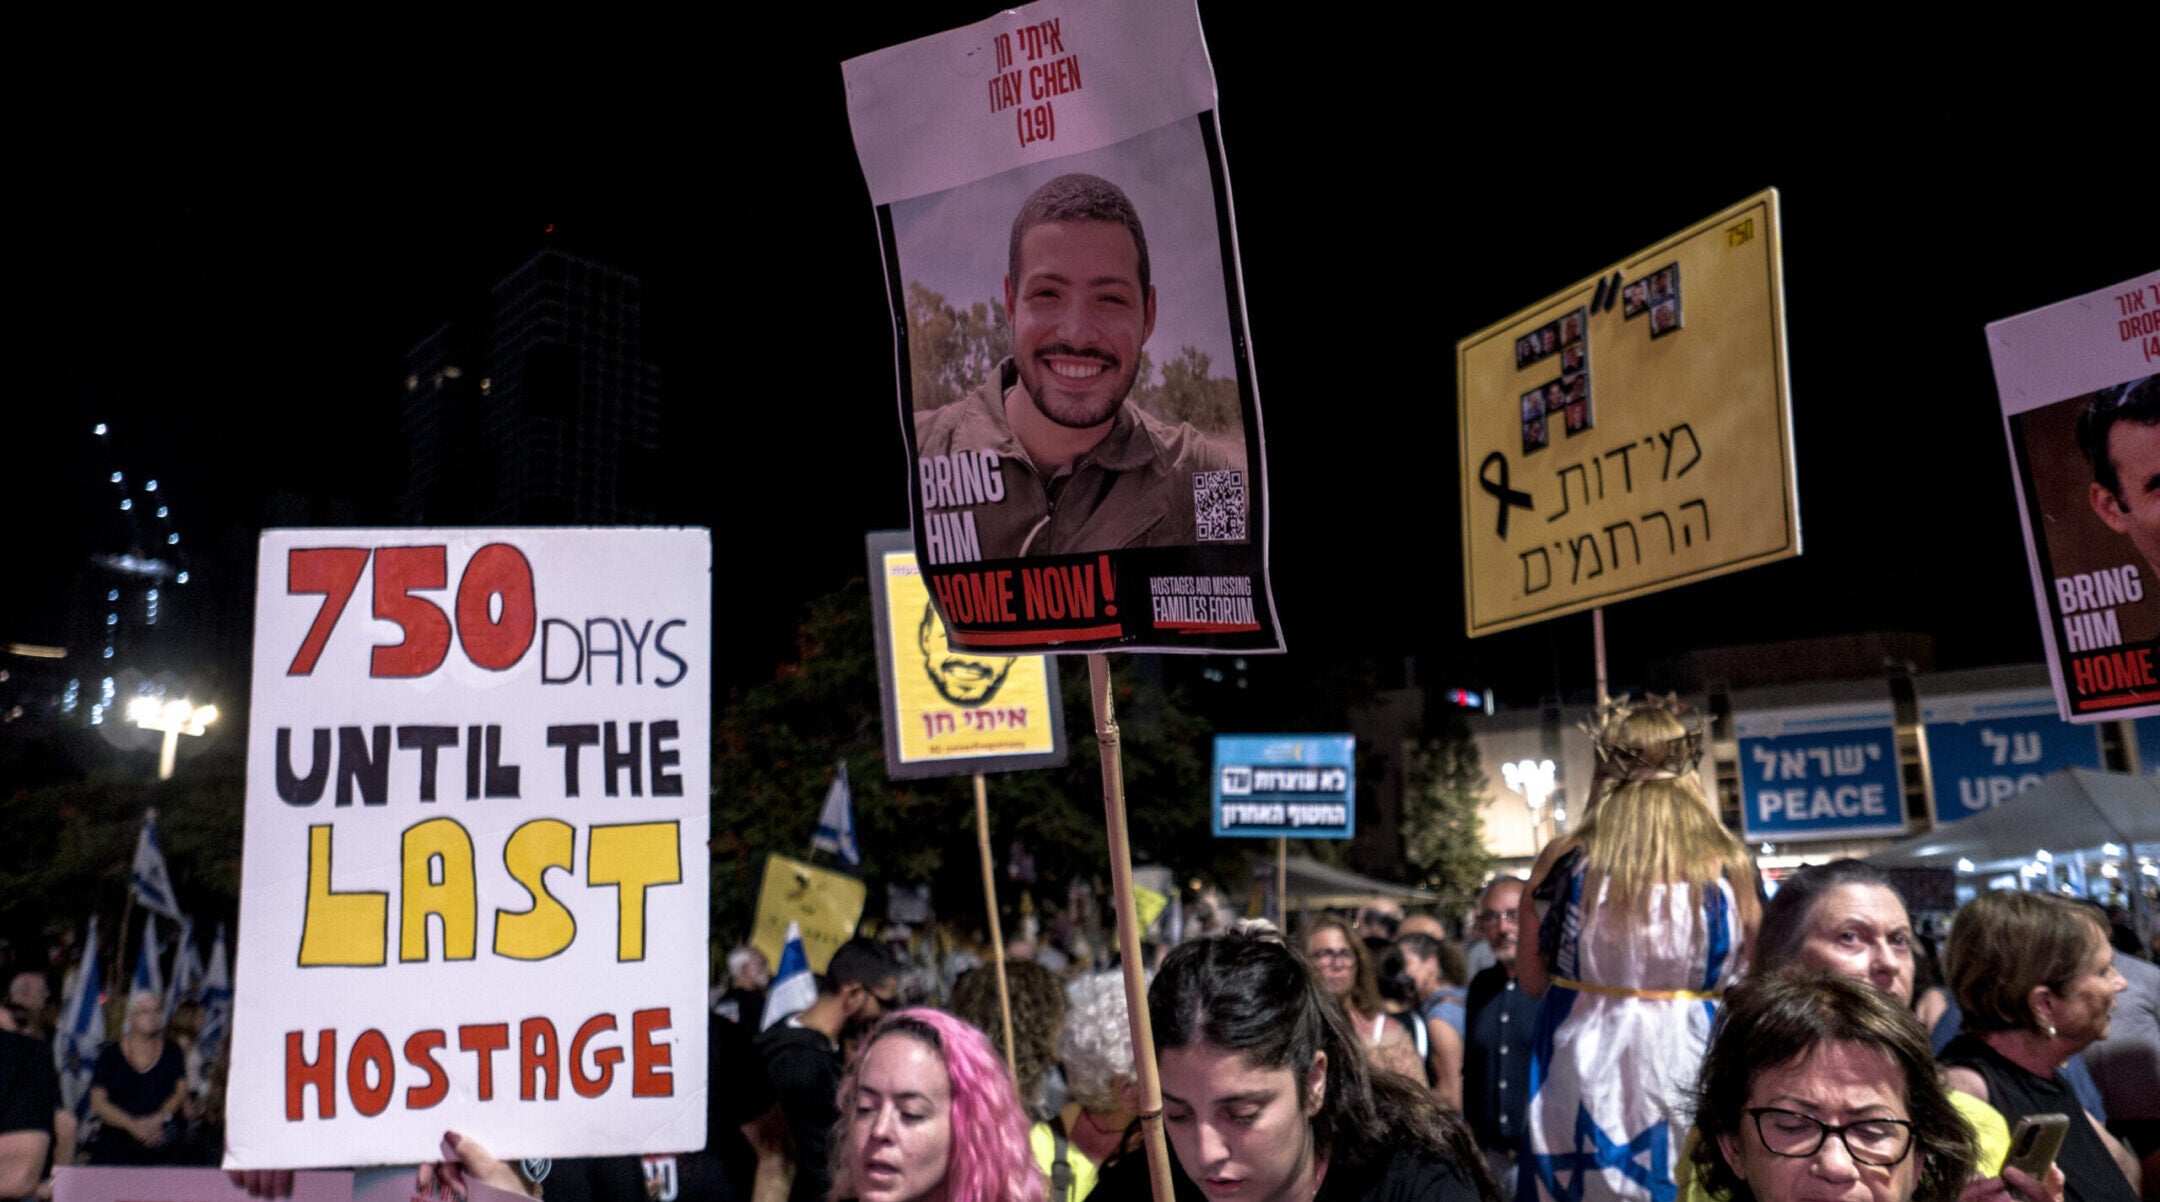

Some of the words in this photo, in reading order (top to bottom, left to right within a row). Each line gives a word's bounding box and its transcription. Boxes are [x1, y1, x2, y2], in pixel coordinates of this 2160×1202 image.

[993, 32, 1014, 74] חן
[1016, 17, 1065, 61] איתי
[988, 69, 1023, 114] ITAY
[1028, 53, 1083, 101] CHEN
[1016, 100, 1056, 149] (19)
[917, 449, 1006, 510] BRING
[1547, 422, 1703, 524] מידות
[923, 510, 983, 566] HIM
[1518, 497, 1711, 596] הרחמים
[932, 569, 1018, 625] HOME
[1149, 576, 1196, 596] HOSTAGES
[1195, 576, 1212, 596] AND
[1212, 576, 1252, 597] MISSING
[1152, 596, 1208, 623] FAMILIES
[1208, 596, 1257, 625] FORUM
[2054, 563, 2144, 615] BRING
[286, 542, 538, 679] 750
[540, 615, 689, 689] DAYS
[2062, 608, 2123, 654] HIM
[2072, 647, 2158, 696] HOME
[922, 711, 956, 741] חן
[963, 707, 1028, 733] איתי
[274, 723, 522, 808] UNTIL
[546, 719, 684, 799] THE
[1752, 742, 1883, 782] ישראל
[1980, 728, 2043, 767] על
[1757, 783, 1888, 823] PEACE
[296, 816, 684, 969] LAST
[284, 1007, 675, 1123] HOSTAGE
